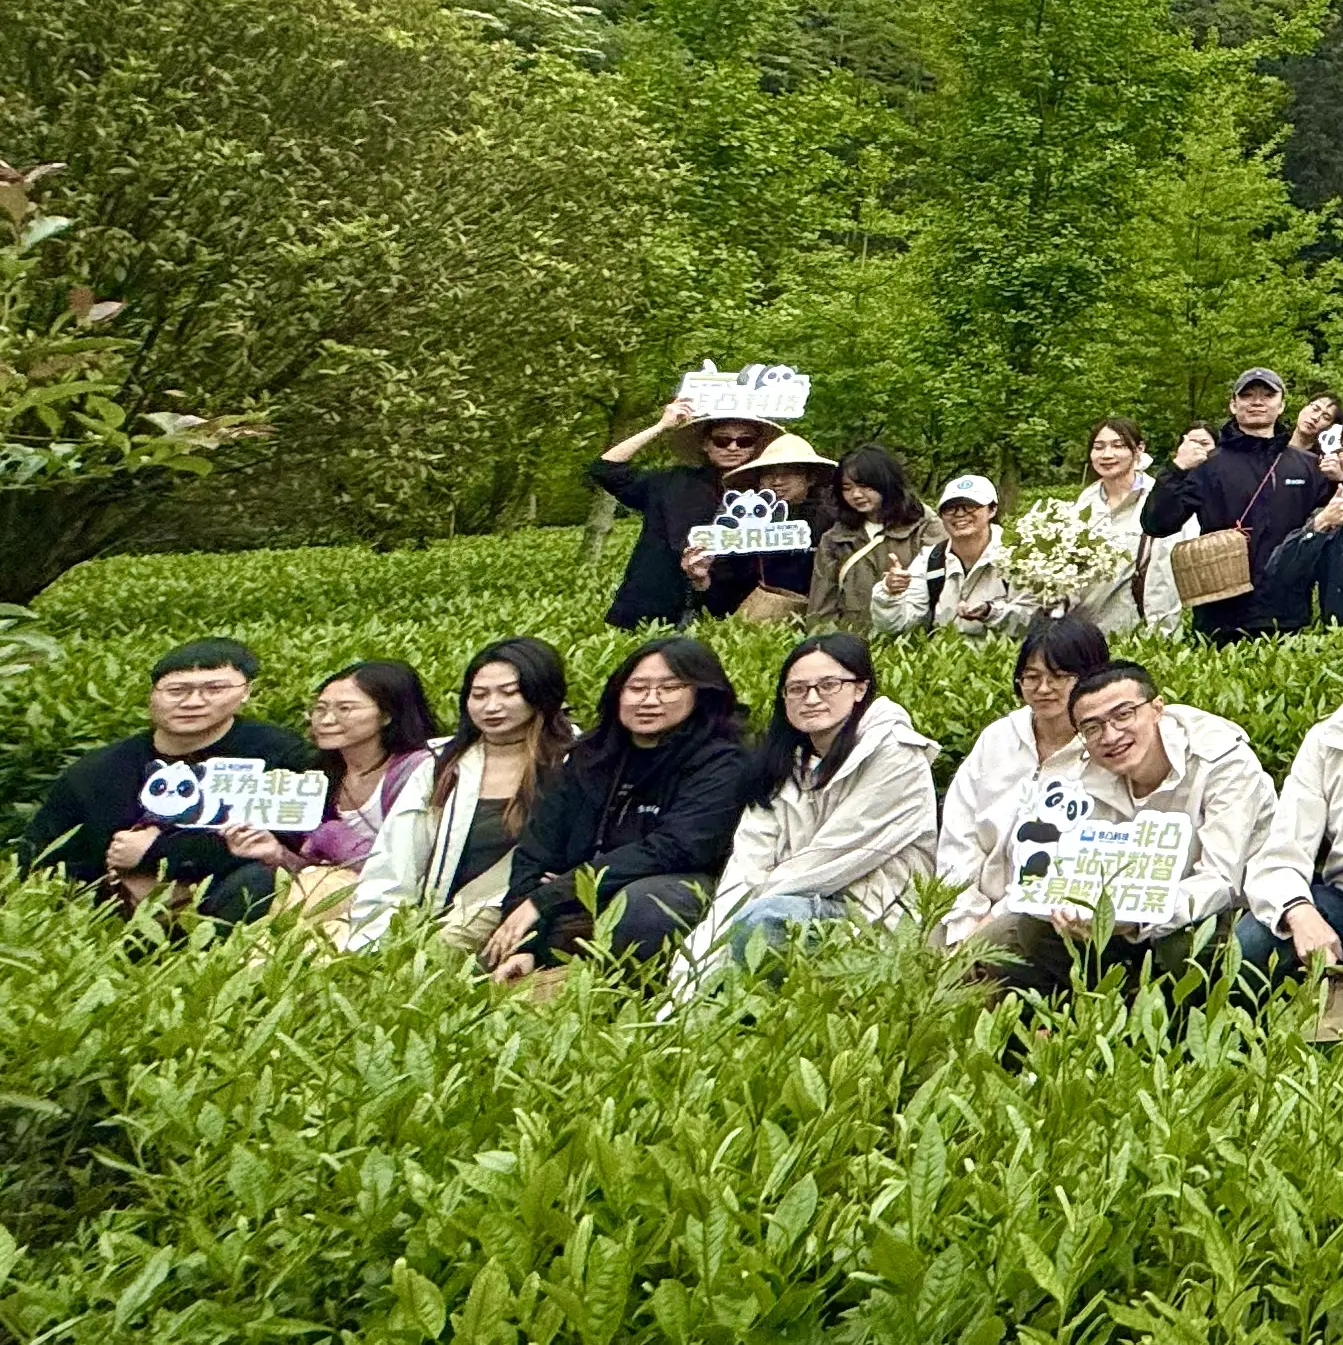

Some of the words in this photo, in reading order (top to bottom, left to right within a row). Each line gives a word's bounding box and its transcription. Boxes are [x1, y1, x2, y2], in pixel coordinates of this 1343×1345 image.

[692, 526, 808, 551] 全员Rust
[211, 771, 324, 797] 我为非凸
[244, 798, 307, 825] 代言
[1134, 820, 1182, 849] 非凸
